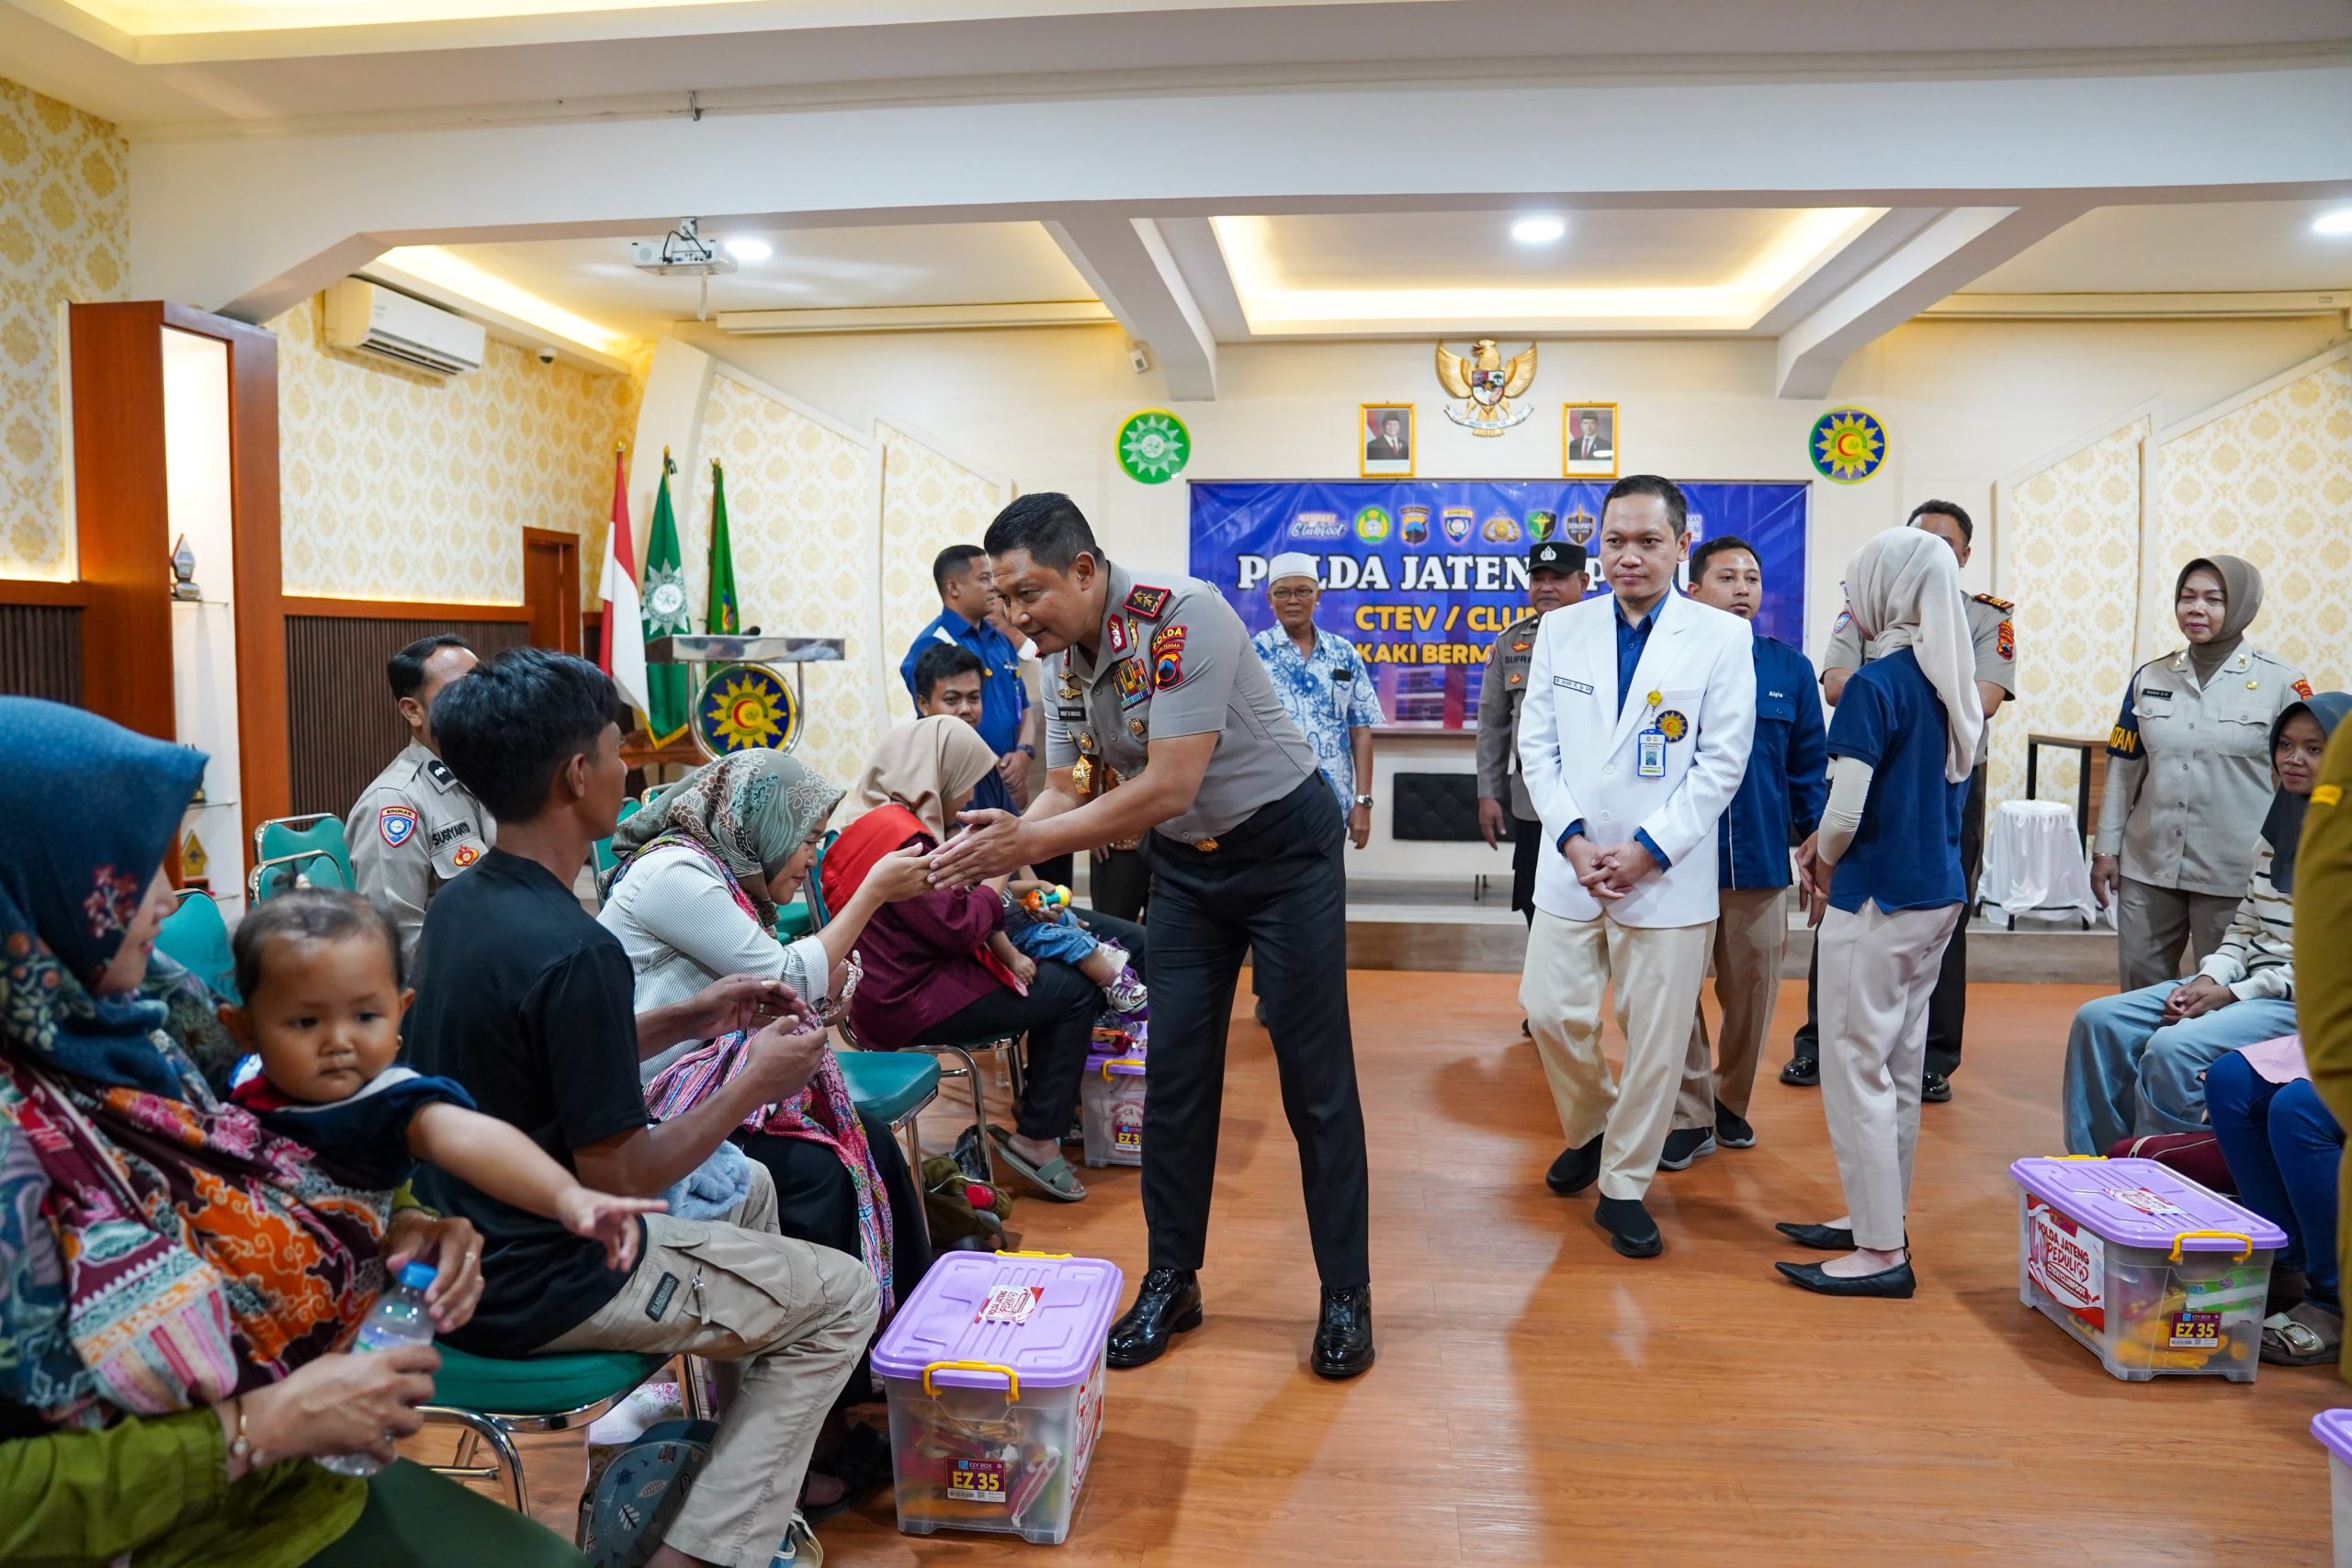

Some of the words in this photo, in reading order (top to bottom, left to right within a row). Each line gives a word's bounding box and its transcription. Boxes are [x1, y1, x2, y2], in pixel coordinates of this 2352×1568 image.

[1355, 605, 1437, 631] CTEV
[1356, 644, 1417, 663] KAKI
[432, 821, 471, 846] SUGIYANTO
[1118, 1133, 1131, 1144] EZ
[1133, 1134, 1141, 1145] 3
[2037, 1220, 2060, 1247] POLDA
[2060, 1236, 2089, 1265] JATENG
[2176, 1323, 2194, 1337] EZ
[2197, 1323, 2215, 1338] 35
[953, 1471, 974, 1489] EZ
[978, 1472, 1000, 1491] 35
